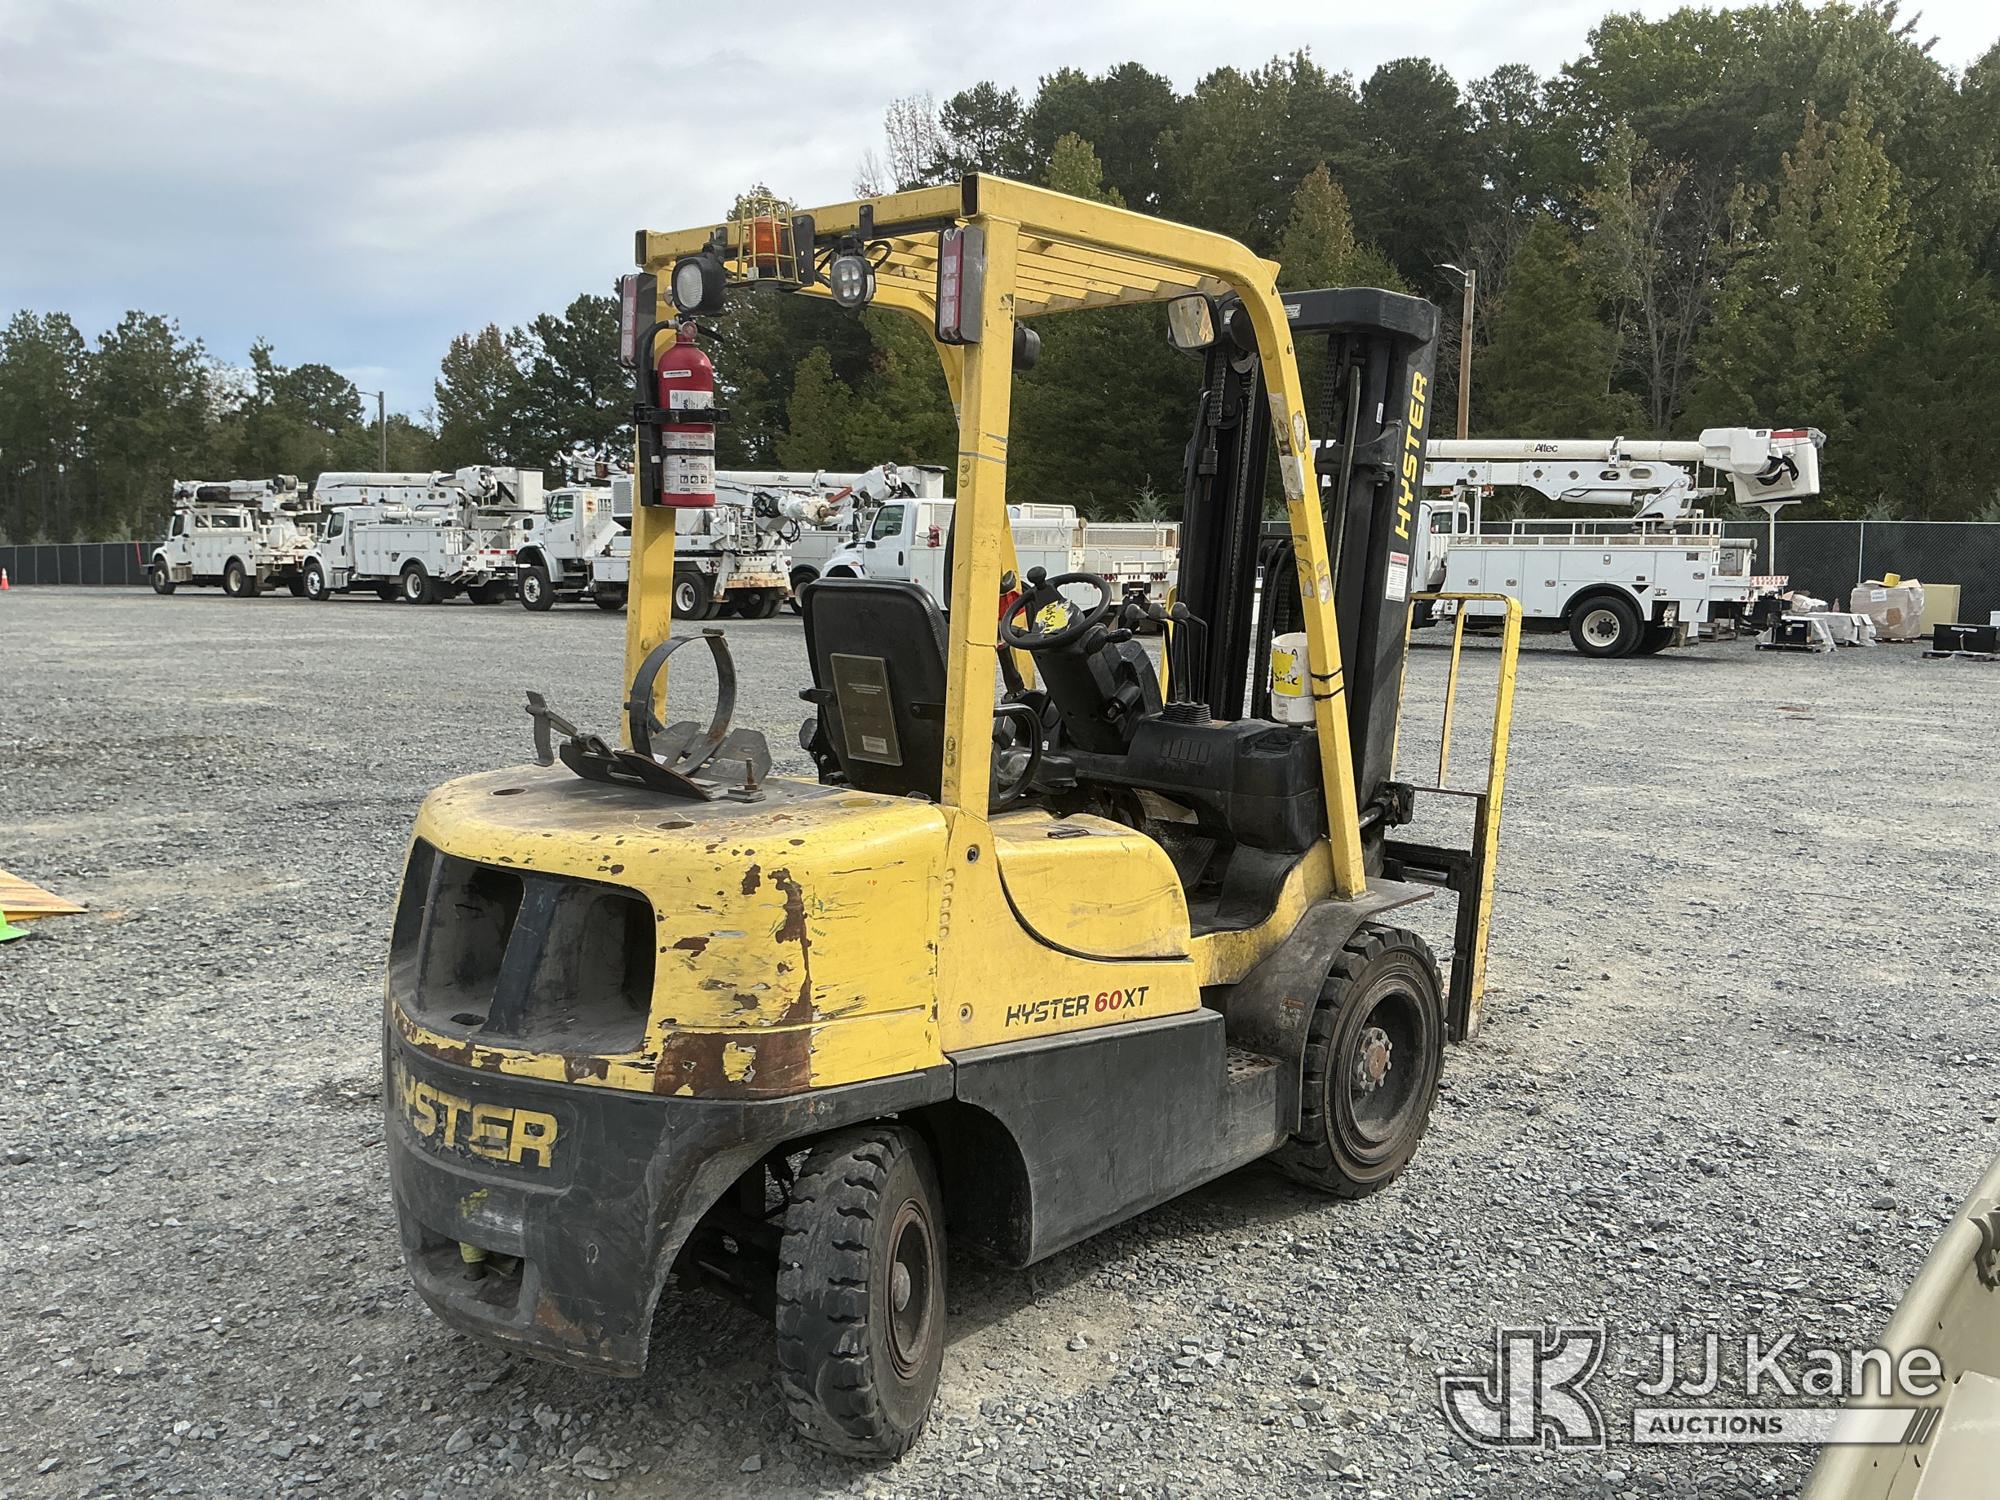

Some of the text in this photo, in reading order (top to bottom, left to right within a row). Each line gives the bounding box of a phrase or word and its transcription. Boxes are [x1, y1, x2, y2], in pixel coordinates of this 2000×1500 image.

[1394, 371, 1428, 540] HYSTER
[1534, 443, 1558, 453] Altec
[1005, 986, 1149, 1027] HYSTER 60XT
